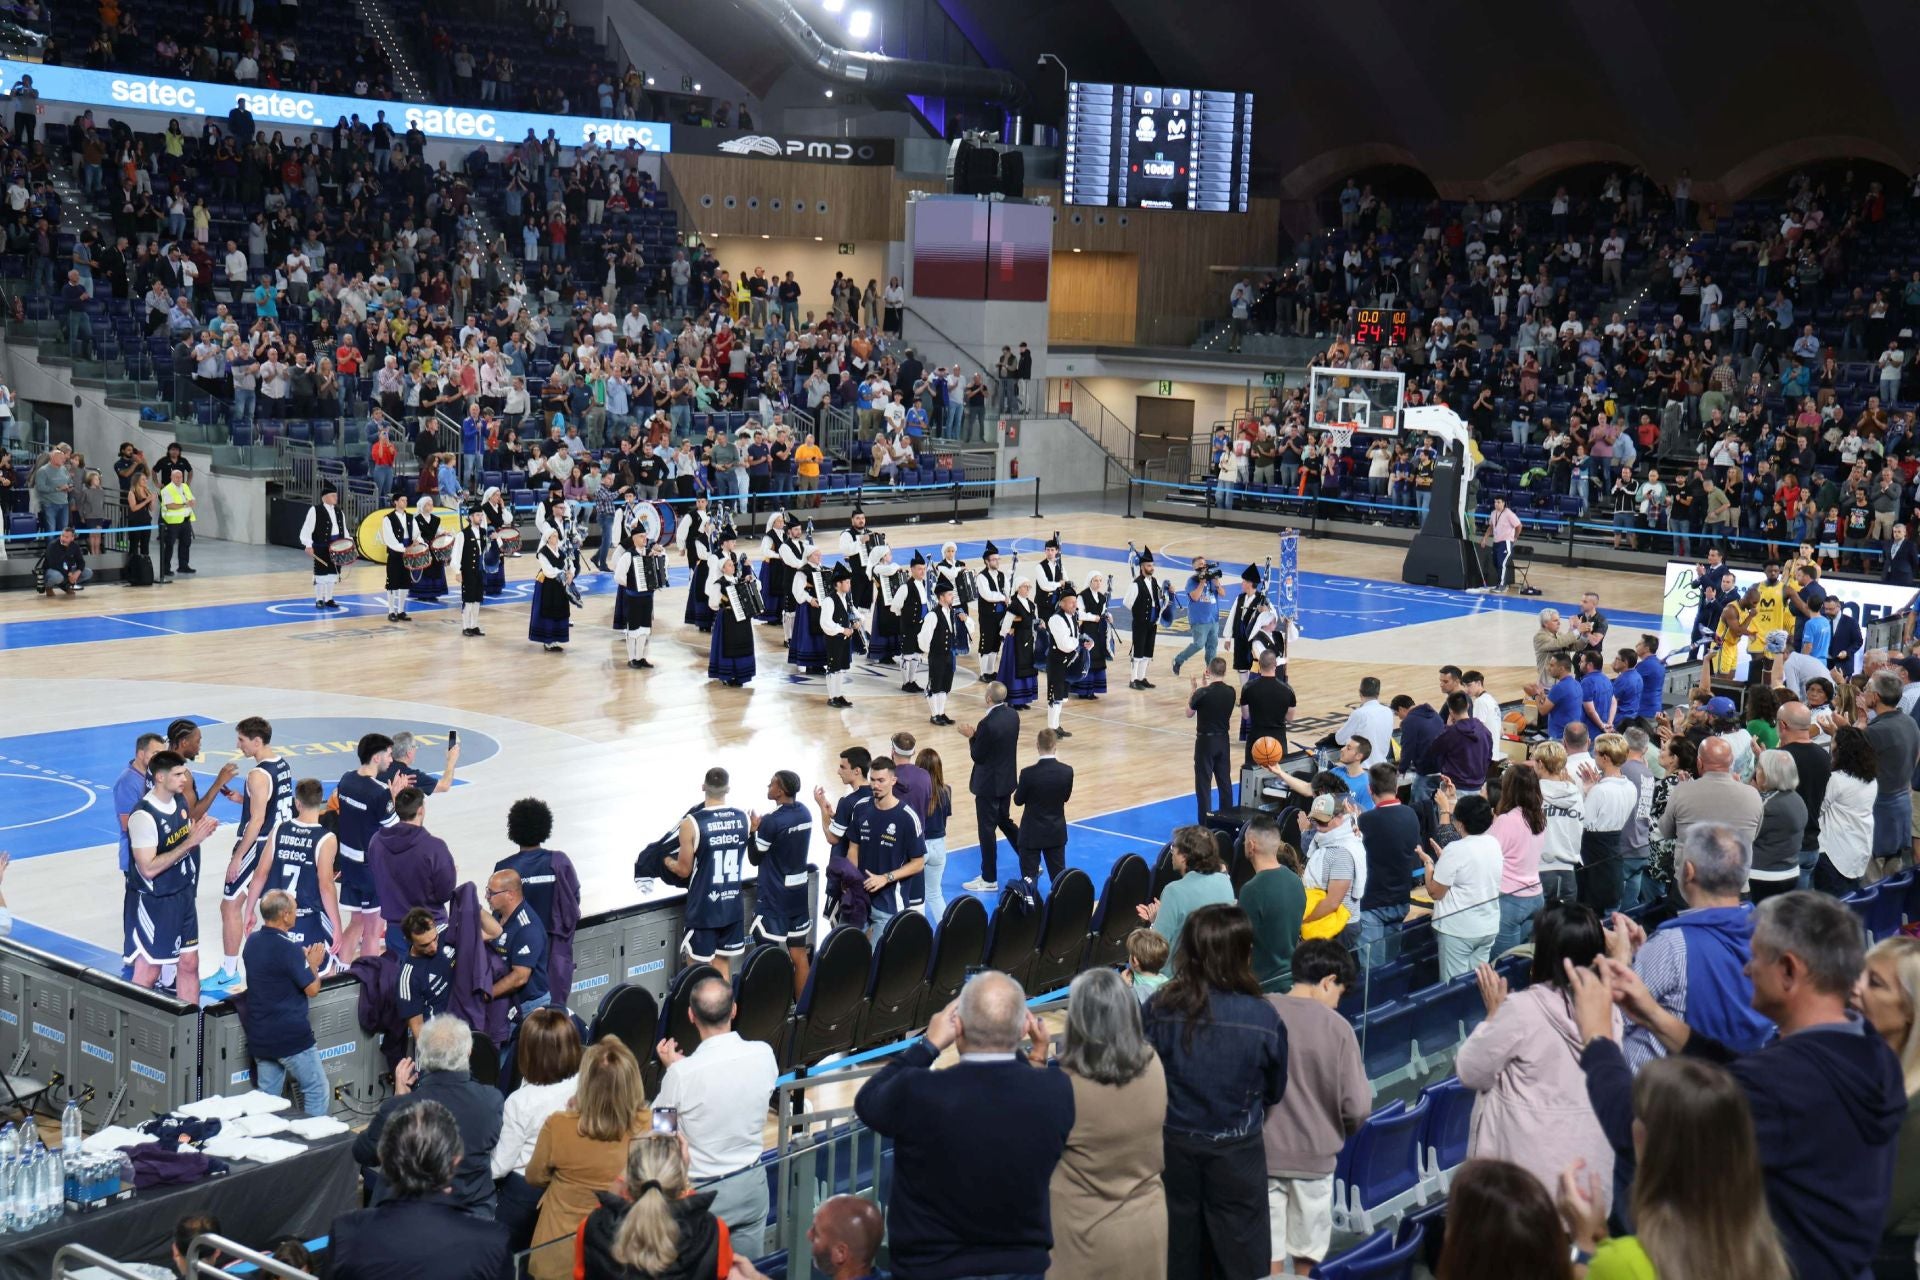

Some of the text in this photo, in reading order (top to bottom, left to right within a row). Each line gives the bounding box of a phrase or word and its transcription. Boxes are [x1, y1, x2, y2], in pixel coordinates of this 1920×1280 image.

[1143, 90, 1181, 105] 0 0
[1357, 311, 1379, 323] 10.0
[1357, 324, 1381, 342] 24
[1392, 325, 1406, 342] 24
[712, 848, 739, 884] 14
[283, 864, 301, 899] 7
[634, 960, 664, 974] MONDO
[578, 975, 609, 991] MONDO
[38, 1025, 65, 1043] MONDO
[87, 1044, 114, 1062] MONDO
[136, 1064, 165, 1082] MONDO
